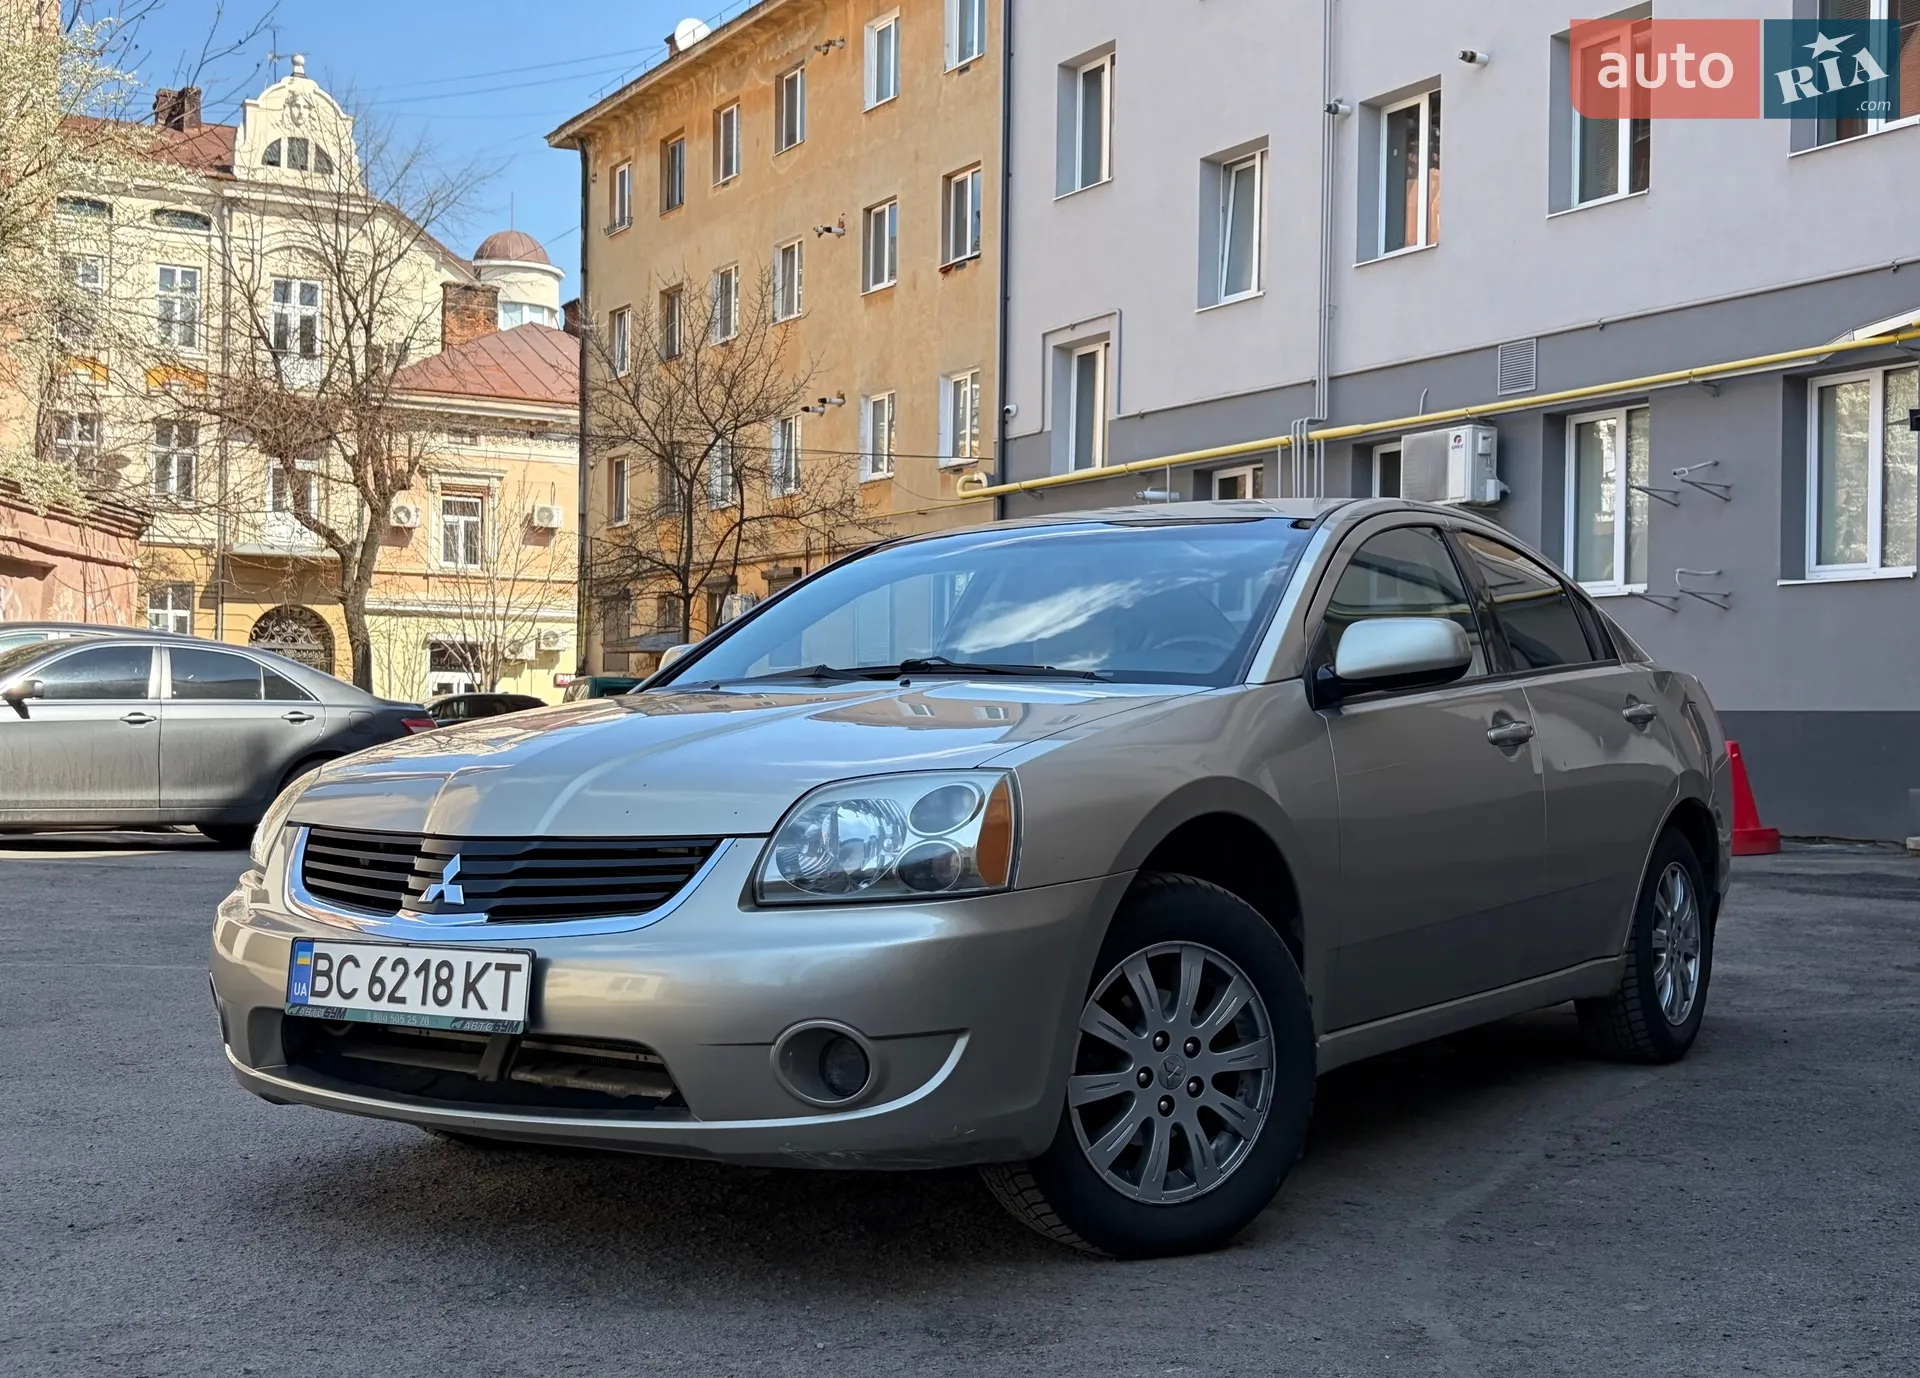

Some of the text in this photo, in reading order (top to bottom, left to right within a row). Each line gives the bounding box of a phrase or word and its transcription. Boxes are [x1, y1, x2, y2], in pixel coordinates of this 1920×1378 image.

[293, 981, 307, 997] UA
[309, 952, 522, 1012] BC 6218 KT
